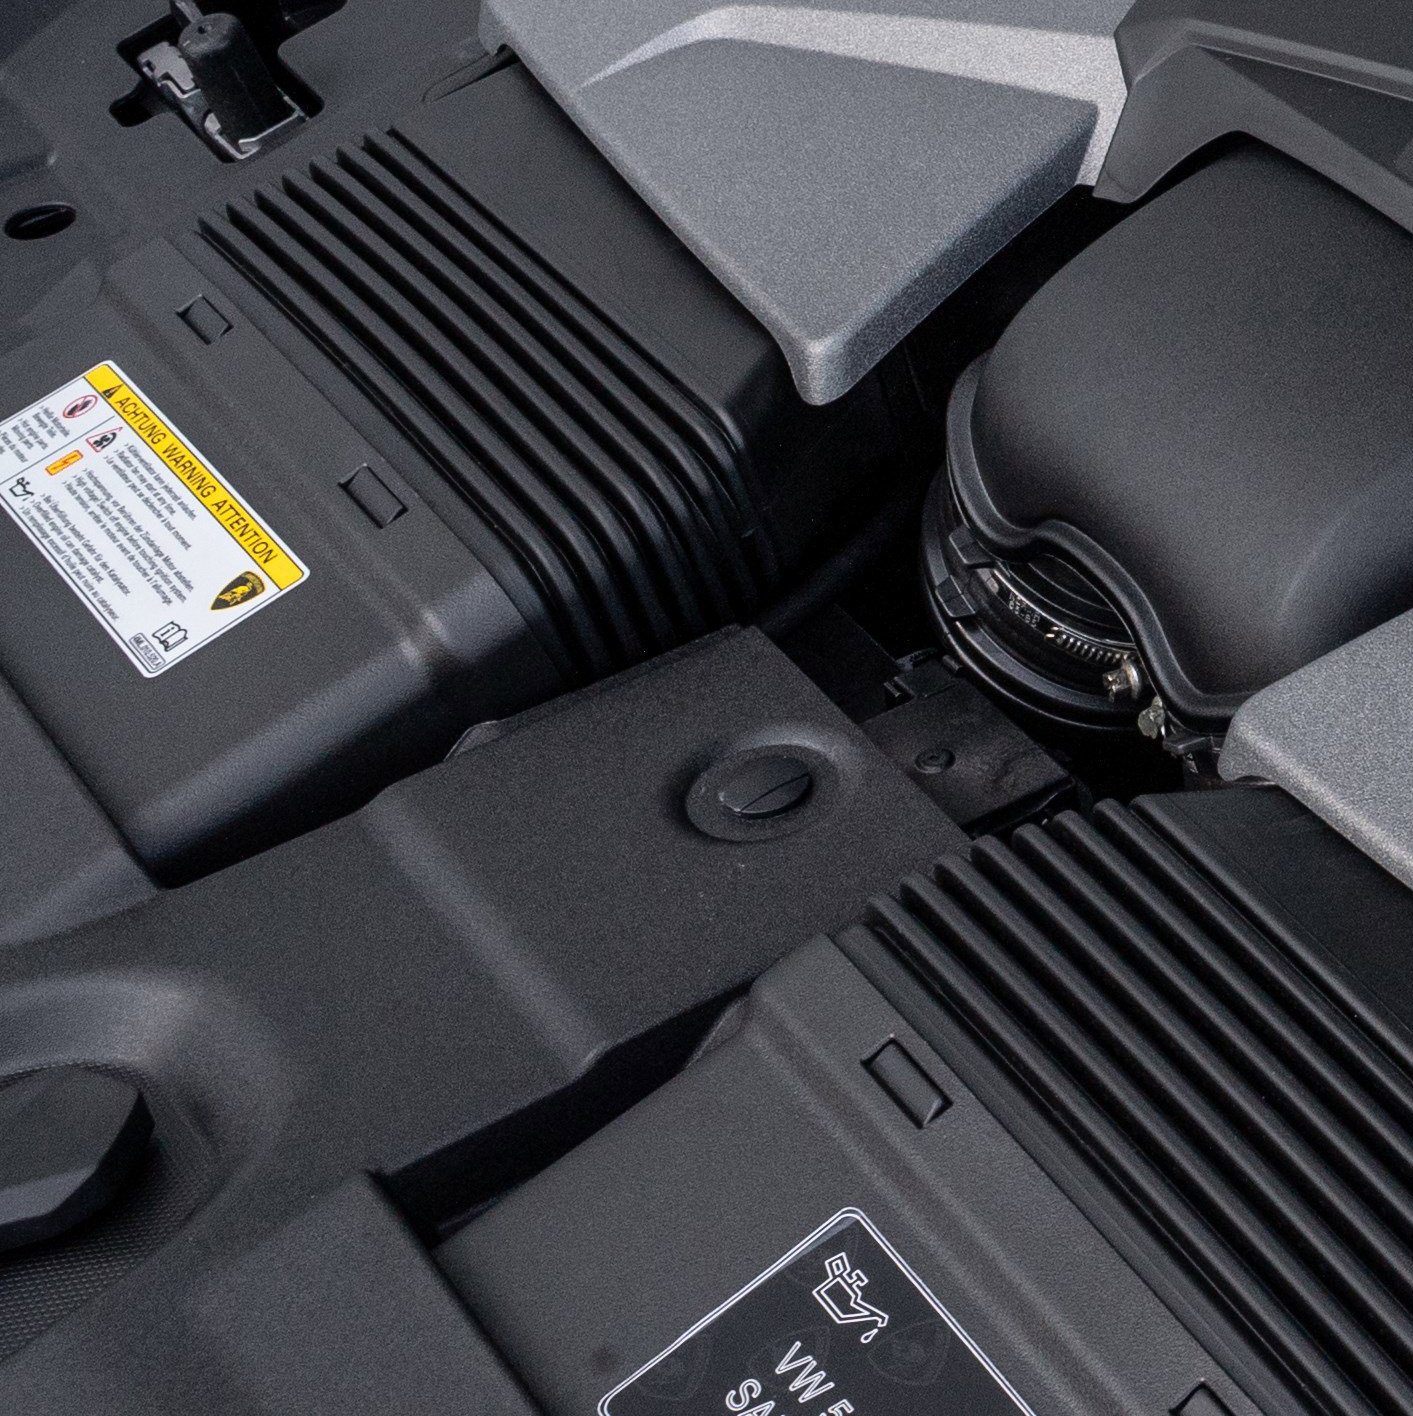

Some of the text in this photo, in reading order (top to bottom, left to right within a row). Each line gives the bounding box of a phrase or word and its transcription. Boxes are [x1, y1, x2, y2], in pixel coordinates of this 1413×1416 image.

[115, 397, 167, 445] ACHTUNG
[162, 443, 216, 498] WARNING
[211, 500, 277, 564] ATTENTION
[162, 555, 177, 571] Motor
[775, 1341, 836, 1403] VW
